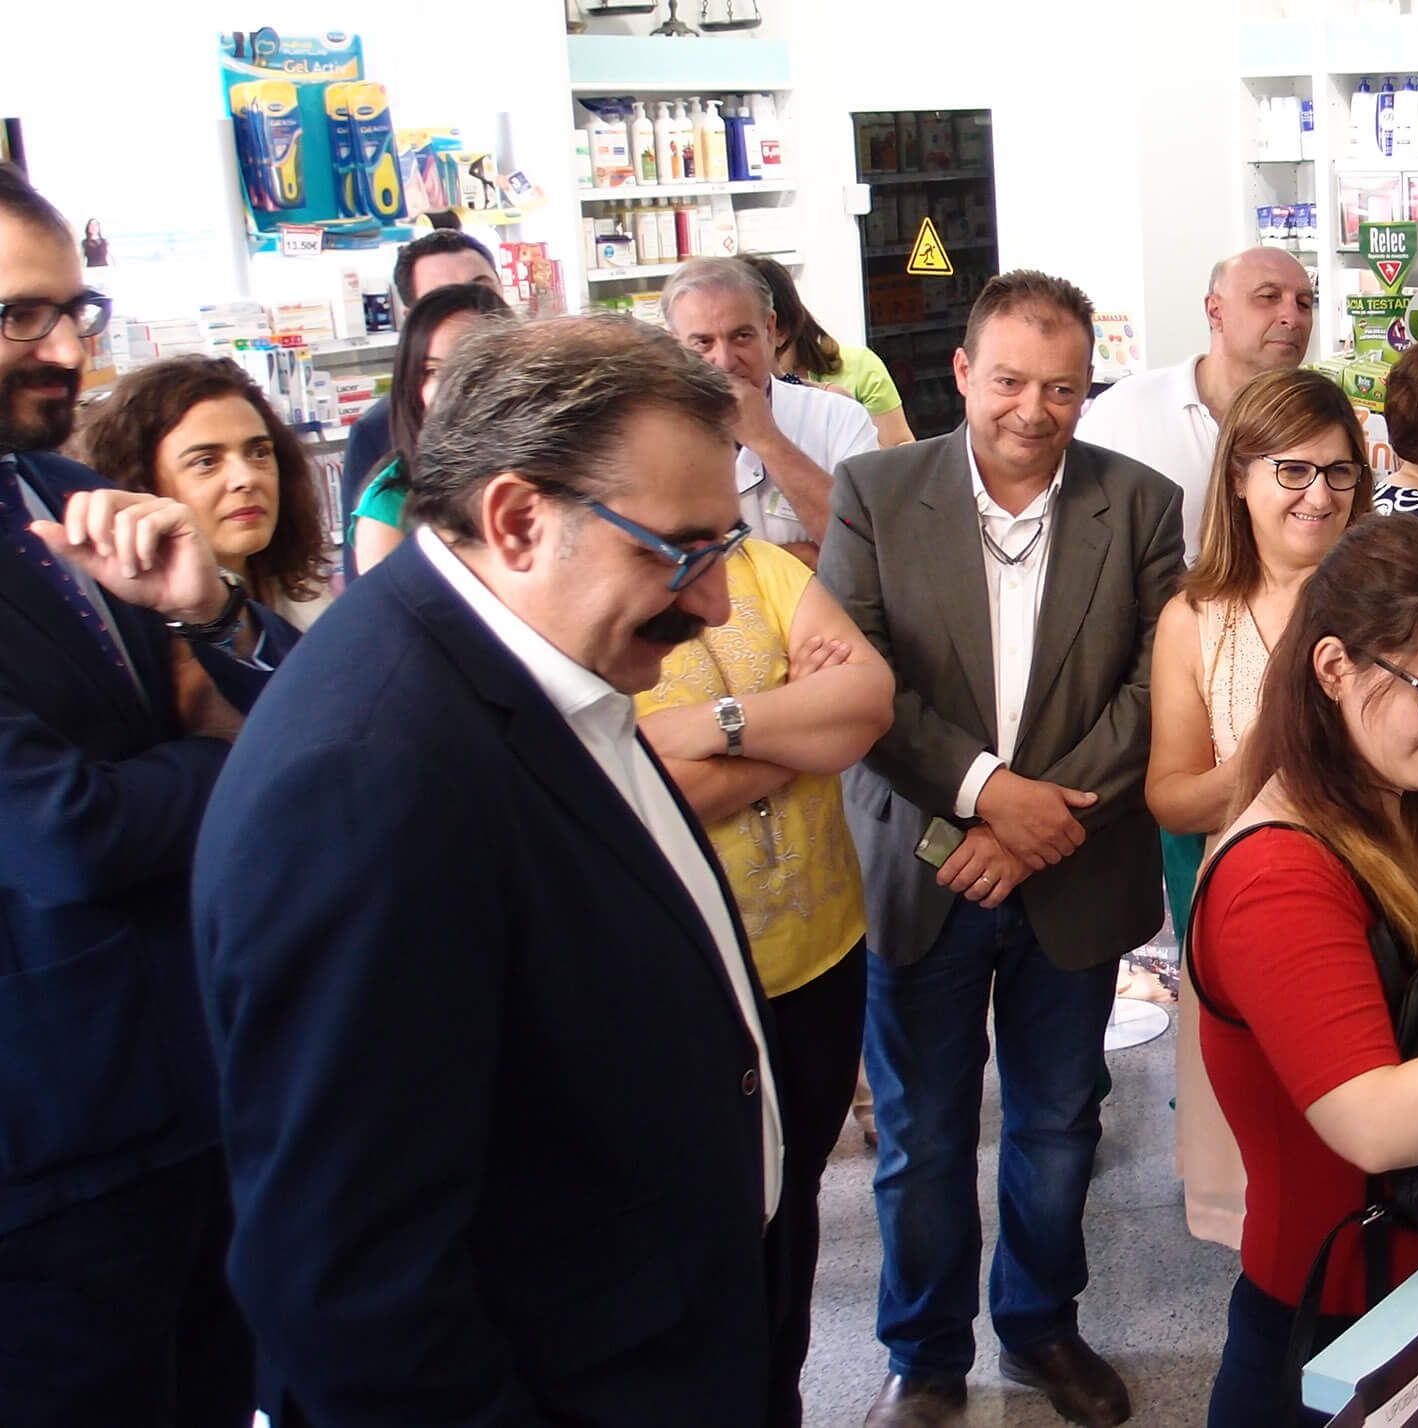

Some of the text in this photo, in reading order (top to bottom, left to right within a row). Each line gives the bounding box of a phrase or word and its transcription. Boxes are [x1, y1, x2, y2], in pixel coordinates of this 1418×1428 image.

[283, 58, 309, 73] Gel
[286, 240, 319, 251] 13.50€
[1370, 227, 1406, 253] Relec
